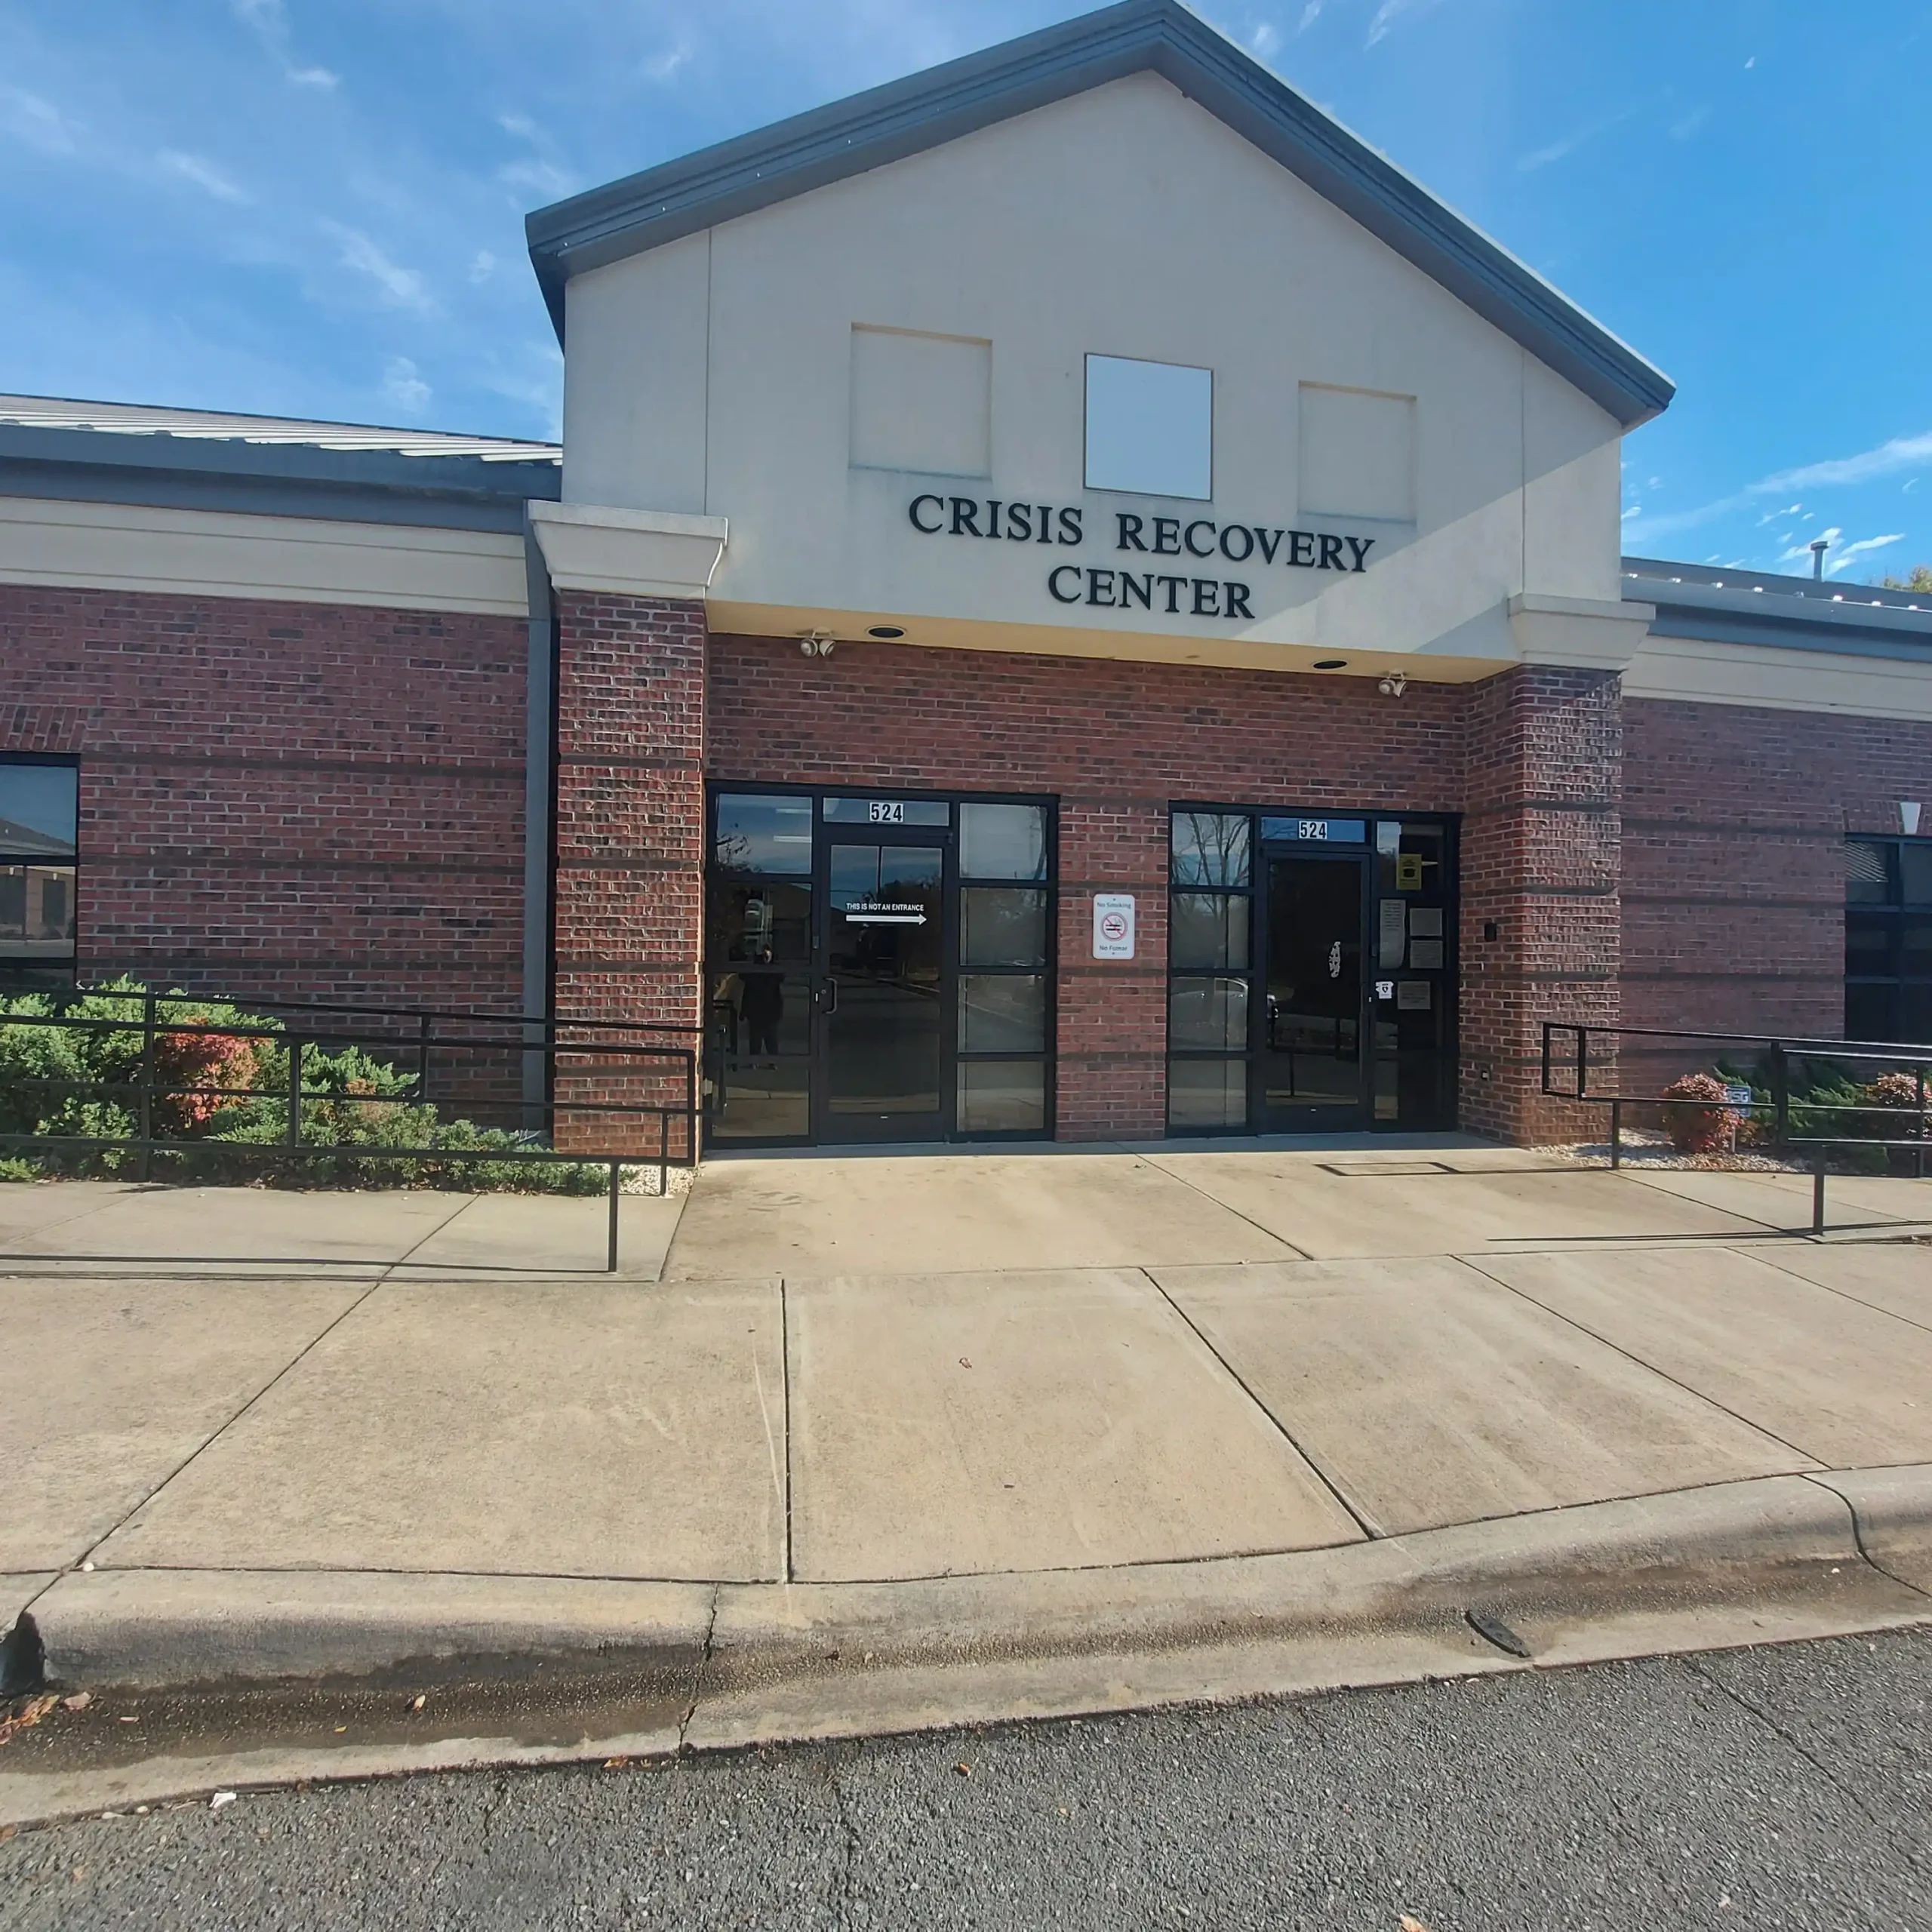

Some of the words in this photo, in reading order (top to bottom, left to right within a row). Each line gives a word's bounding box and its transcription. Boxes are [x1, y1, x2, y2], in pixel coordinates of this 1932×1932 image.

[909, 494, 1083, 546] CRISIS
[1116, 513, 1375, 572] RECOVERY
[1048, 565, 1255, 619] CENTER
[871, 804, 902, 821] 524
[1300, 821, 1327, 838] 524
